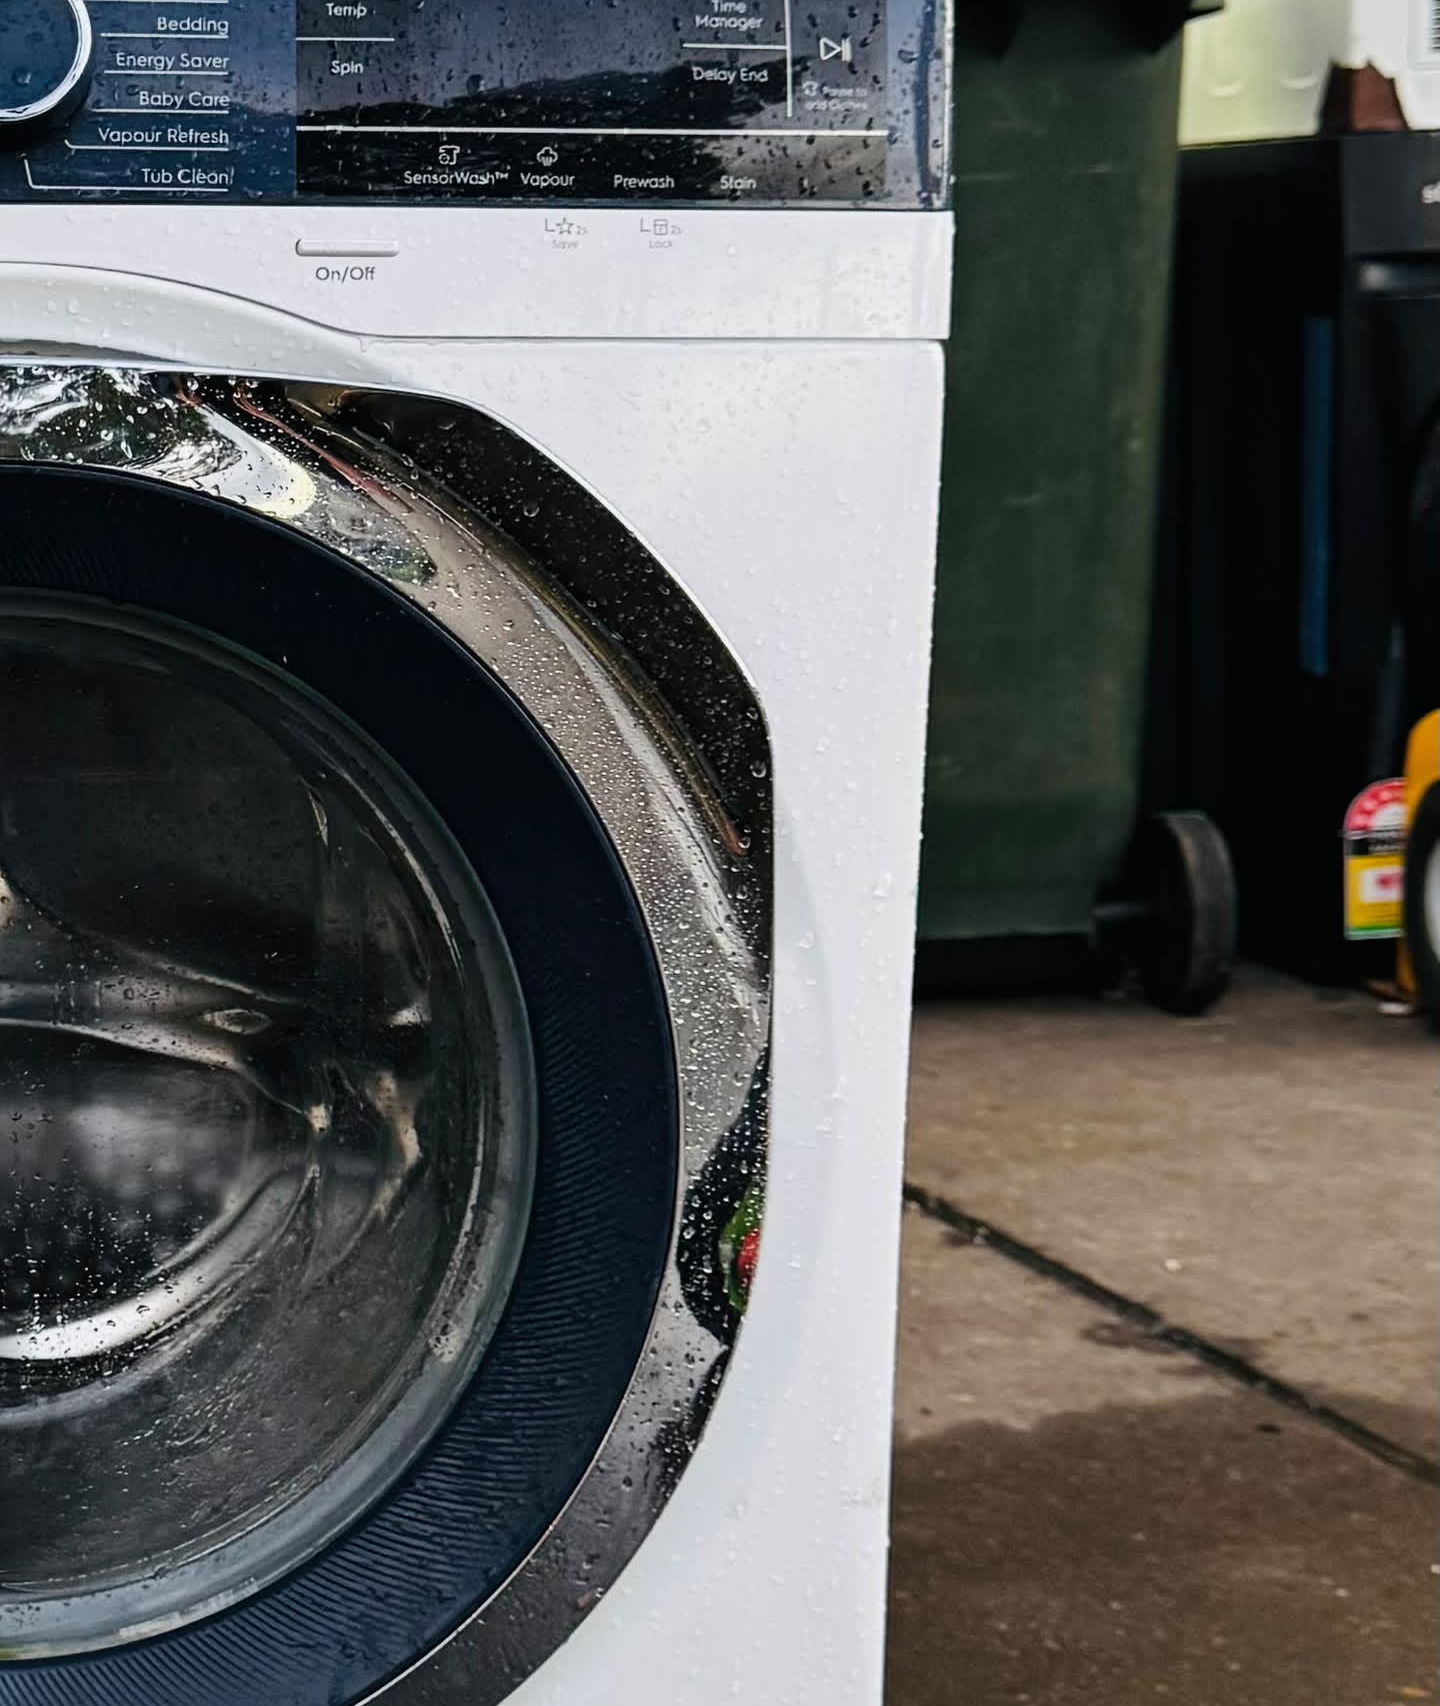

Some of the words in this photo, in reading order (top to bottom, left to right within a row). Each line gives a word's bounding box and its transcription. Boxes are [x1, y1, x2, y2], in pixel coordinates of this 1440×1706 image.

[325, 3, 367, 19] Temp
[711, 0, 746, 13] Time
[157, 17, 228, 34] Bedding
[695, 15, 764, 31] Manager
[116, 53, 176, 70] Energy
[180, 54, 228, 68] Saver
[330, 60, 364, 76] Spin
[692, 66, 737, 84] Delay
[740, 68, 768, 81] End
[139, 92, 190, 109] Baby
[194, 93, 230, 107] Care
[98, 127, 162, 145] Vapour
[167, 129, 229, 144] Refresh
[141, 169, 172, 184] Tub
[177, 170, 228, 184] Clean
[520, 172, 574, 189] Vapour
[613, 174, 675, 188] Prewash
[720, 175, 756, 189] Stain
[315, 267, 375, 283] On/Off
